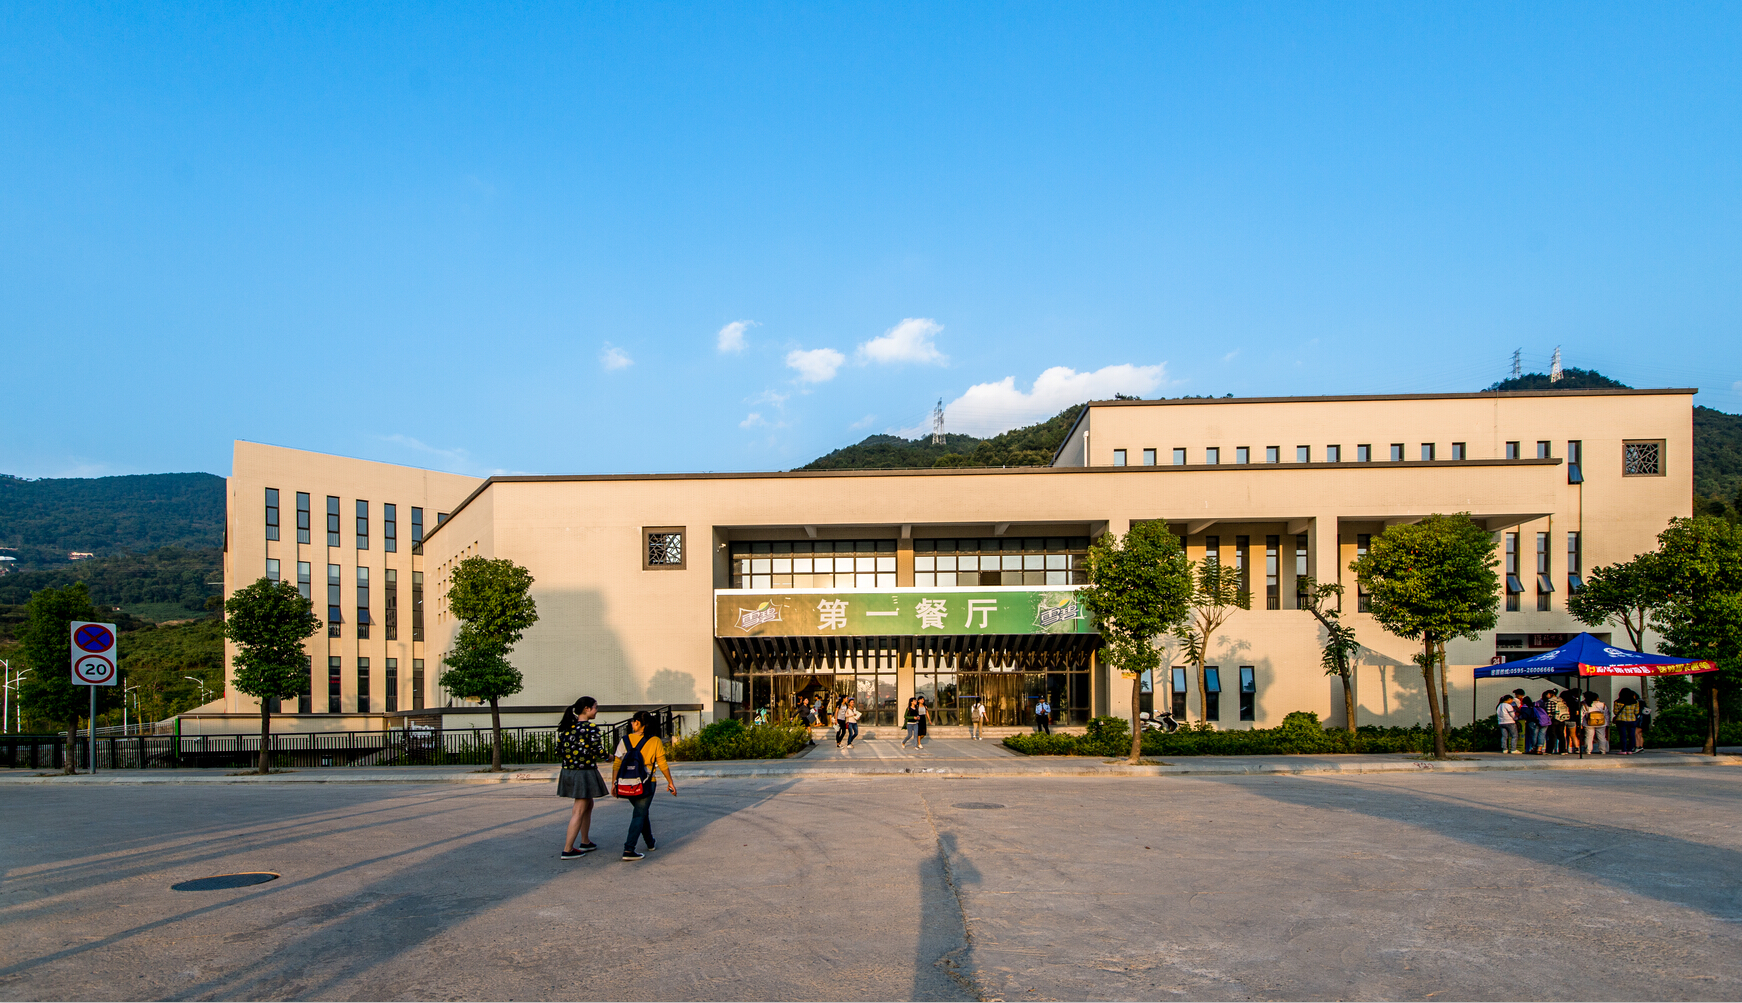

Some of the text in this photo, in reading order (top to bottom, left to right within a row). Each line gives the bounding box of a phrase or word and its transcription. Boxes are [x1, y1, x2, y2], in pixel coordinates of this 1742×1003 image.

[741, 605, 779, 629] 雪碧
[817, 598, 998, 630] 第一餐厅
[1040, 604, 1080, 627] 雪碧
[85, 663, 107, 676] 20
